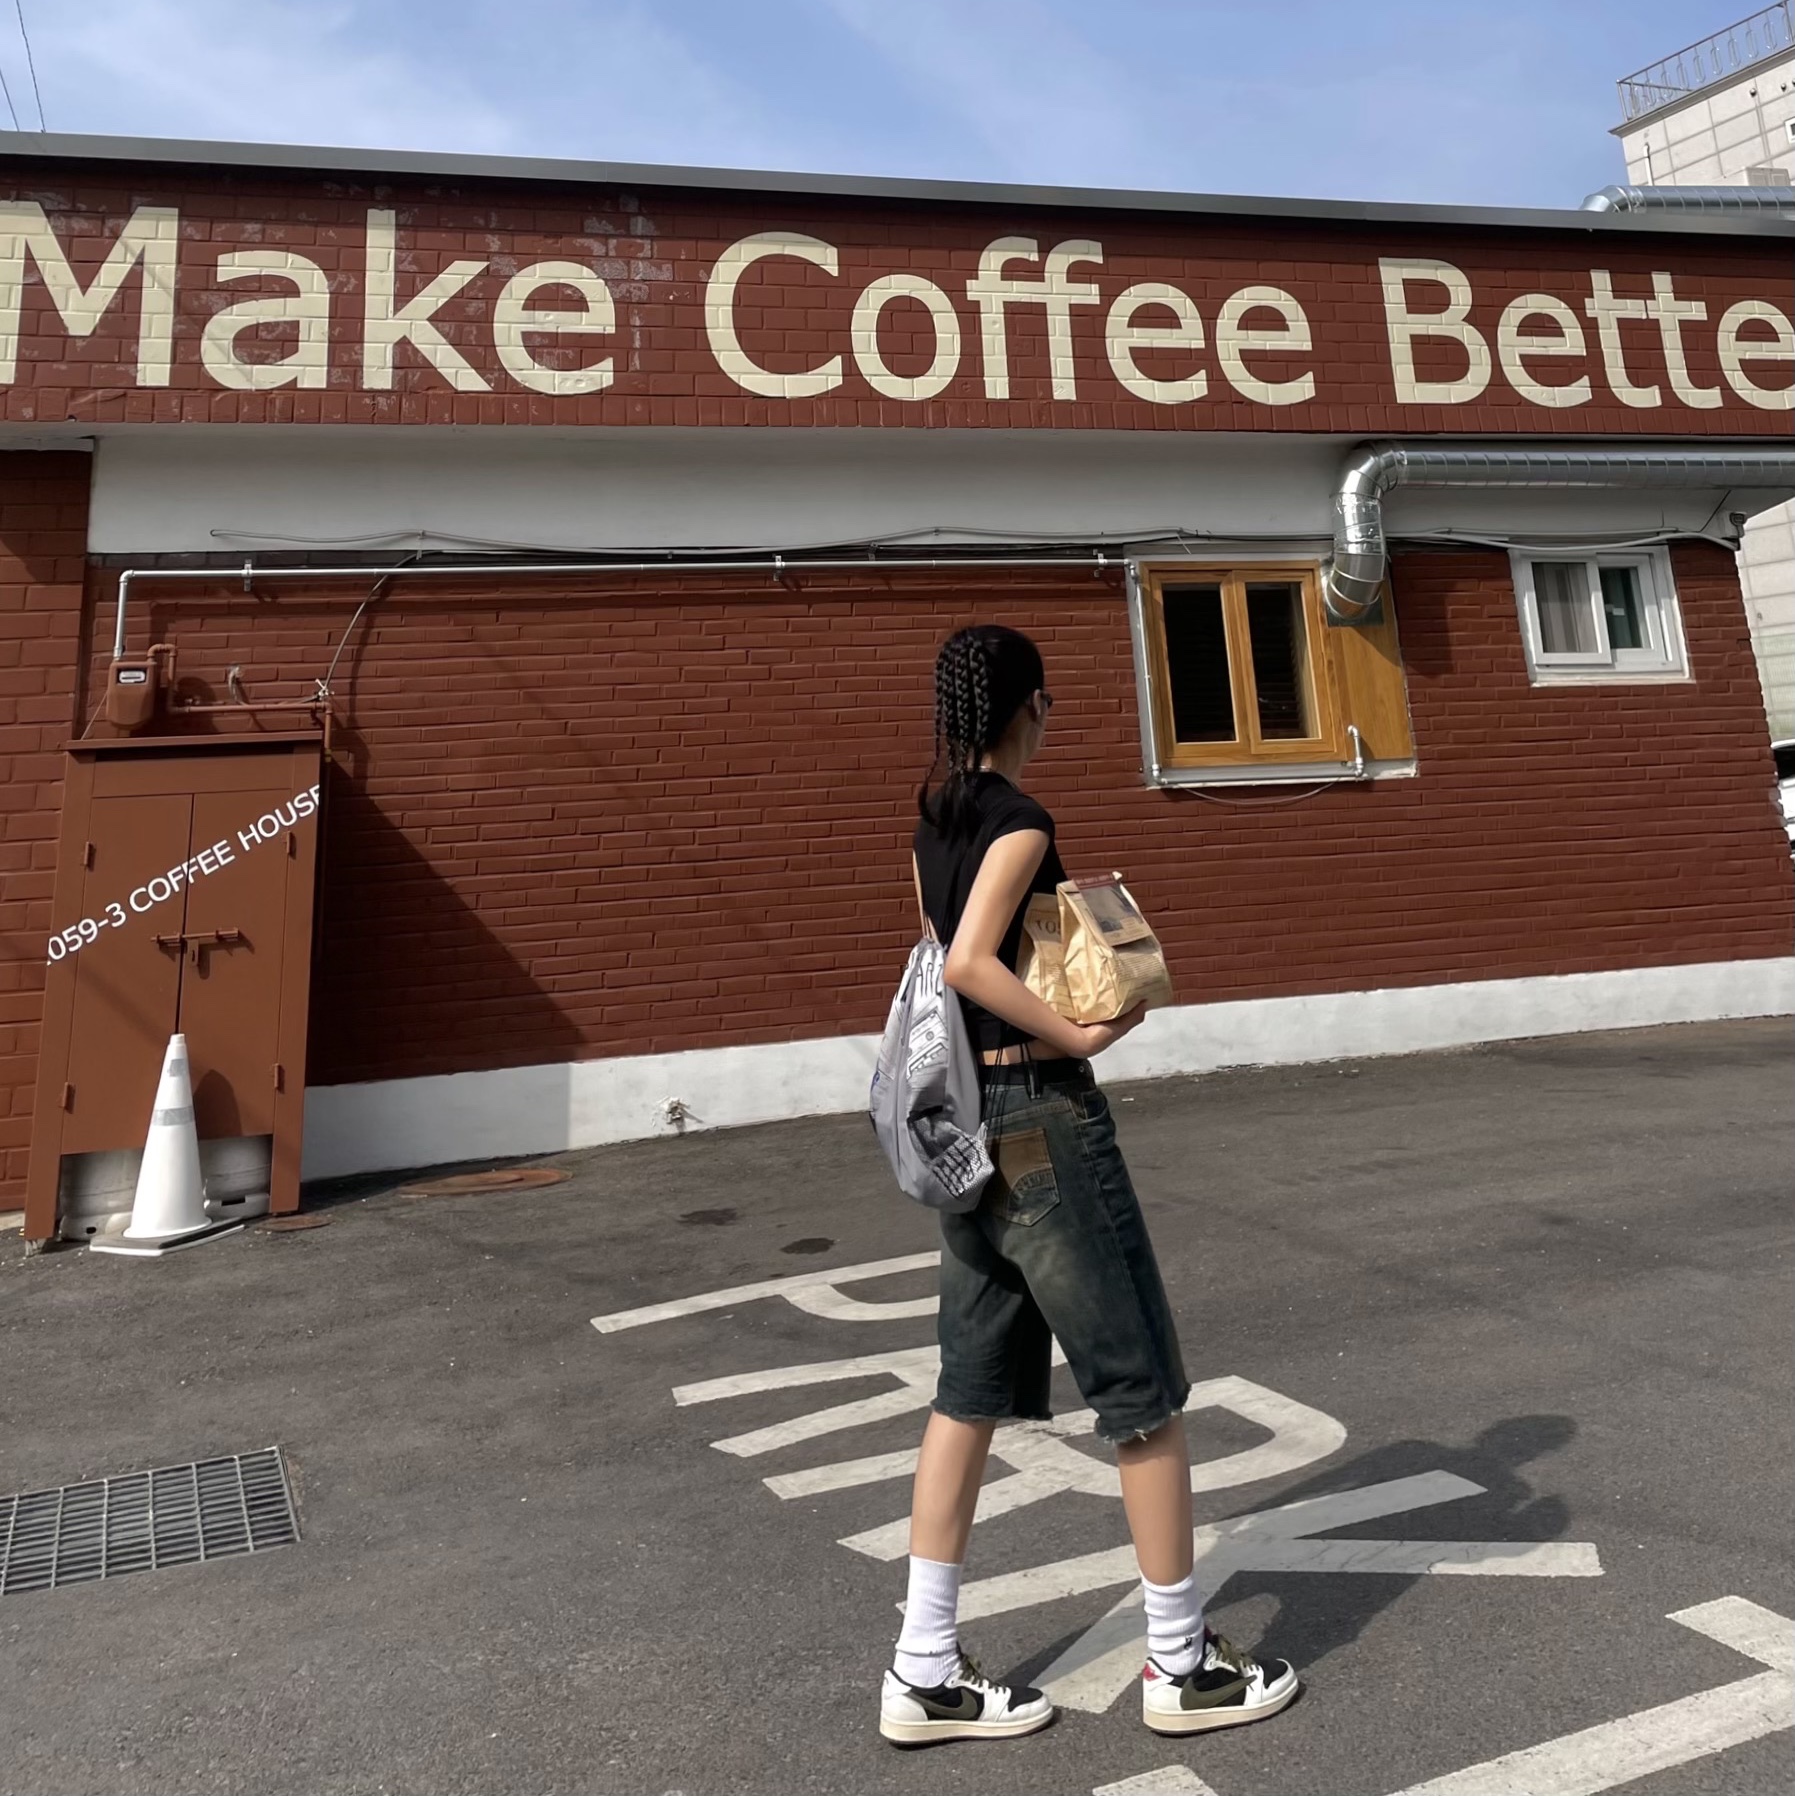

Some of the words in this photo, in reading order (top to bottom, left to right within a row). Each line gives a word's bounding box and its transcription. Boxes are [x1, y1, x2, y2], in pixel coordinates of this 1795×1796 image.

[0, 200, 616, 395] Make
[704, 232, 1316, 405] Coffee
[1378, 256, 1795, 410] Bette
[47, 903, 127, 966] 059-3
[130, 840, 235, 912] COFFEE
